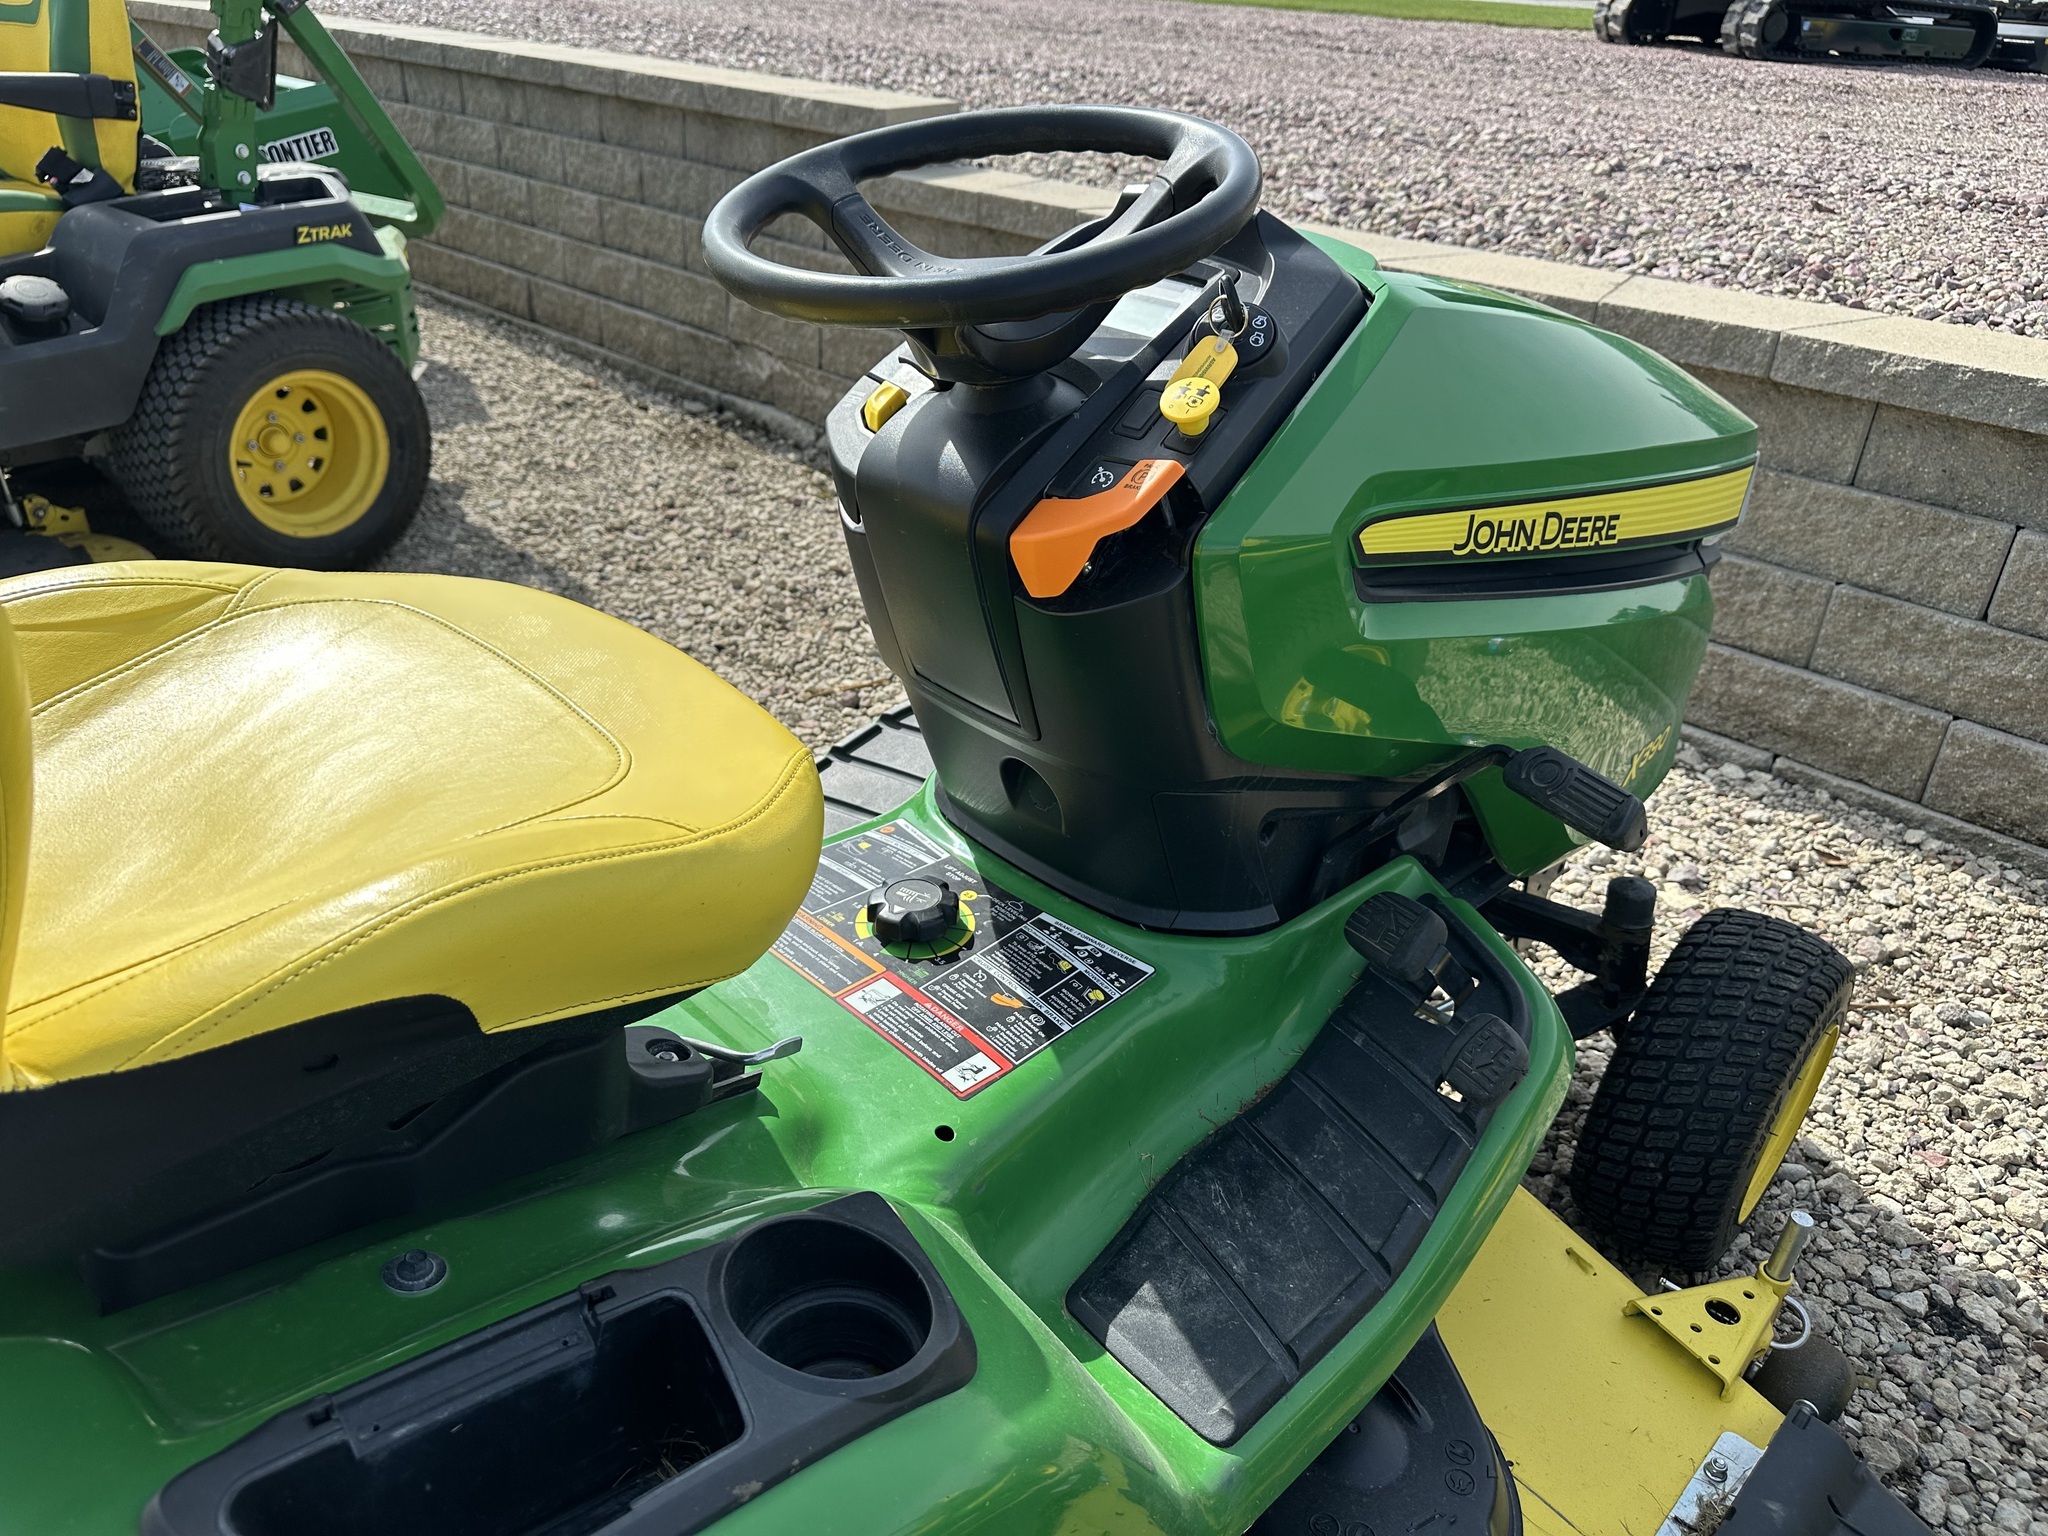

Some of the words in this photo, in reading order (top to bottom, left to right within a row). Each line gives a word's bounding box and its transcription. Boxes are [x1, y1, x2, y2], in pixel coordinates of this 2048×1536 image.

[262, 130, 336, 163] ONTIER
[297, 223, 353, 245] ZTRAK
[860, 213, 916, 264] DEERE
[1452, 513, 1537, 551] JOHN
[1539, 511, 1621, 546] DEERE
[944, 864, 957, 872] LIFT
[955, 871, 977, 883] ADJUST
[945, 872, 961, 880] STOP
[992, 897, 1005, 906] DECK
[1005, 906, 1027, 921] LEVELING
[995, 905, 1016, 919] POSITION
[816, 915, 835, 927] LOWER
[1054, 921, 1073, 932] BRAKE
[1077, 932, 1105, 948] FORWARD
[1109, 949, 1136, 964] REVERSE
[1057, 938, 1069, 947] FWD
[897, 970, 917, 984] HIGHER
[962, 973, 977, 983] CRUISE
[973, 957, 993, 971] CRUISE
[993, 971, 1018, 990] CONTROL
[1094, 966, 1106, 975] REV
[1051, 995, 1068, 1008] MOWER
[1066, 1007, 1077, 1015] OFF
[1059, 993, 1070, 1002] Raise
[1070, 1001, 1082, 1012] handle
[1061, 988, 1079, 1003] MOWER
[893, 1009, 909, 1020] around
[914, 1002, 935, 1018] ROTATING
[934, 1017, 952, 1031] BLADES
[950, 1030, 961, 1038] CUT
[931, 1006, 963, 1031] DANGER
[1027, 996, 1043, 1009] PARK
[1044, 1009, 1064, 1026] BRAKE
[1048, 999, 1061, 1009] Lower
[1061, 1008, 1073, 1020] handle
[873, 1012, 884, 1020] while
[883, 1019, 899, 1032] backing
[877, 1008, 888, 1017] Look
[887, 1016, 899, 1025] down
[905, 1030, 920, 1041] behind
[918, 1040, 932, 1051] before
[895, 1016, 905, 1024] mow
[908, 1026, 923, 1038] reverse
[905, 1010, 914, 1018] mow
[914, 1017, 925, 1026] when
[924, 1025, 941, 1038] children
[945, 1041, 959, 1053] others
[919, 1013, 933, 1023] ARMS
[932, 1022, 942, 1030] AND
[941, 1029, 954, 1039] LEGS
[1013, 1011, 1025, 1021] PARK
[1024, 1020, 1039, 1032] BRAKE
[868, 1014, 879, 1023] Never
[878, 1022, 889, 1031] carry
[888, 1030, 905, 1043] children
[903, 1042, 914, 1051] even
[922, 1056, 936, 1068] blades
[995, 1022, 1007, 1031] PARK
[1005, 1030, 1020, 1042] BRAKE
[1019, 1041, 1029, 1049] OFF
